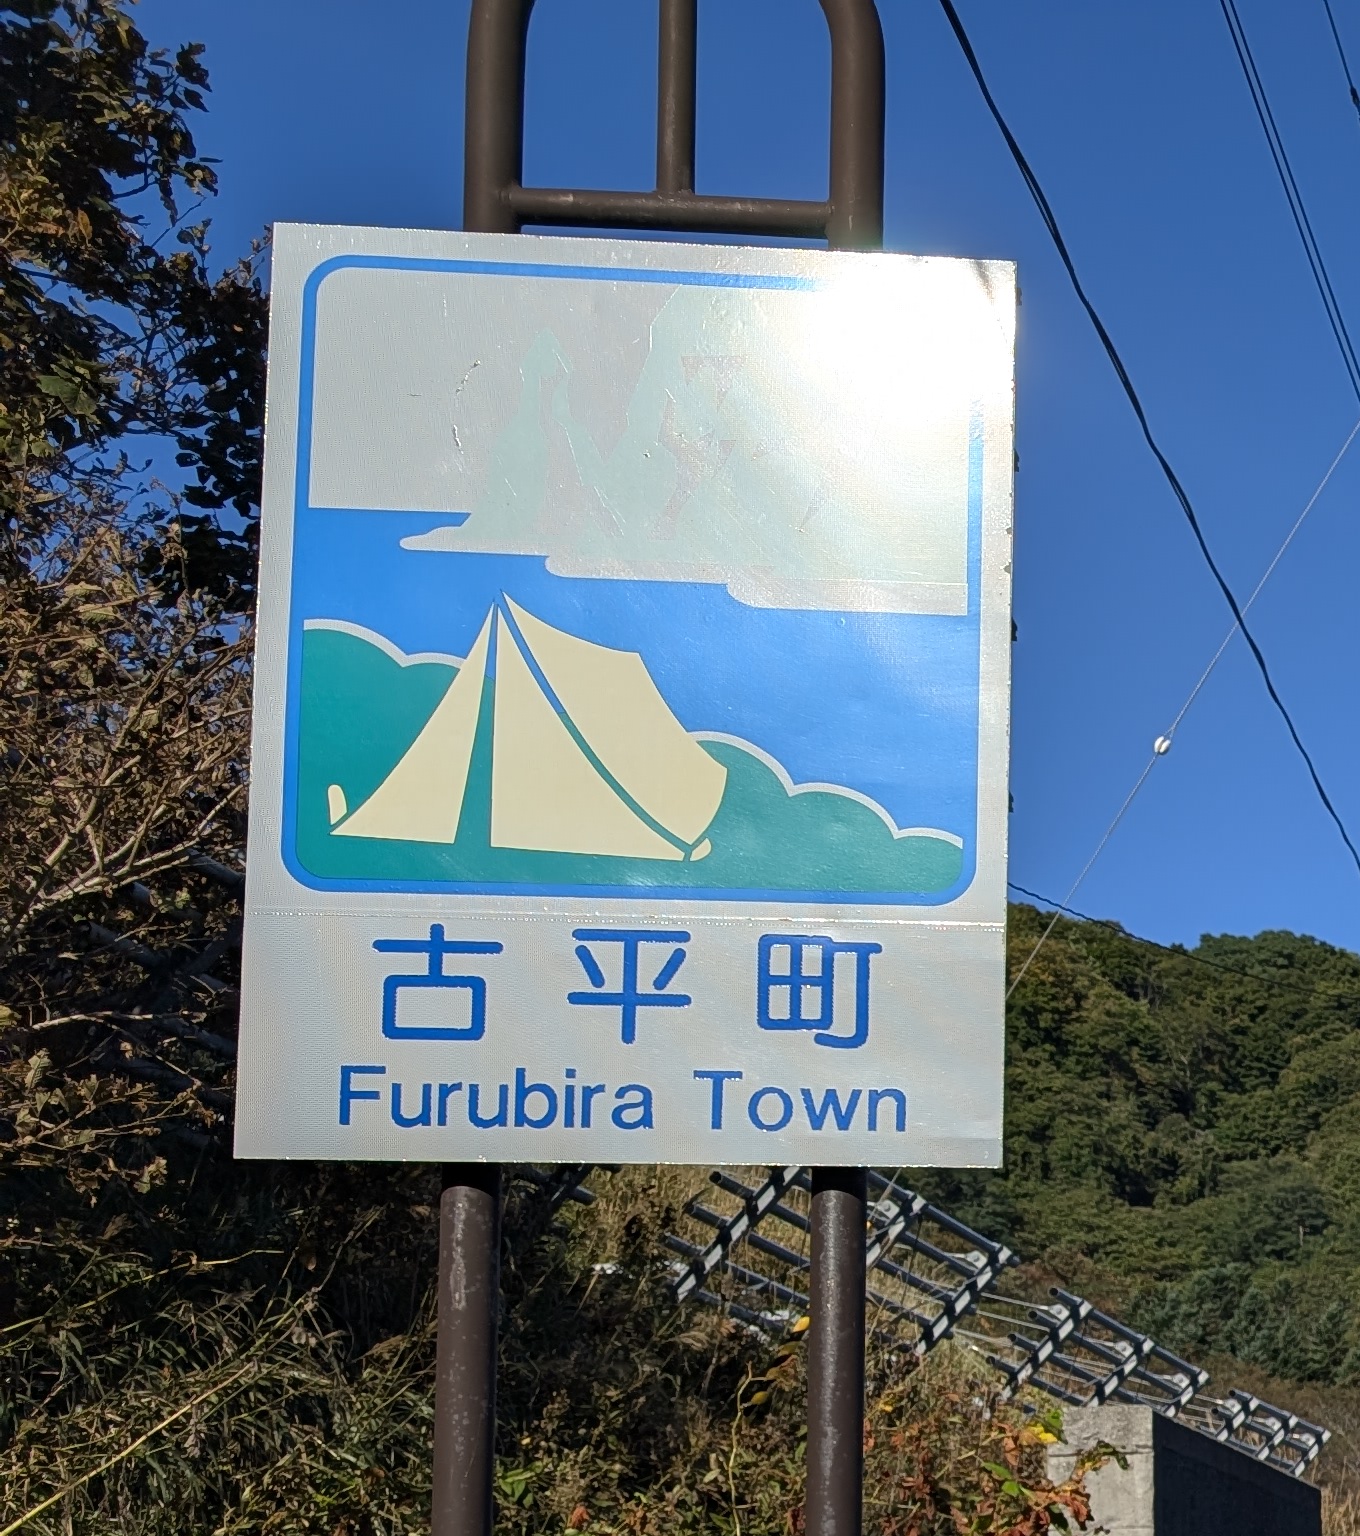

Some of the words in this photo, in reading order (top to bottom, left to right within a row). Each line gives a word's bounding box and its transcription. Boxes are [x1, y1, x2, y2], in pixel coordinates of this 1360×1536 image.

[373, 923, 882, 1048] 古平町
[338, 1065, 654, 1131] Furubira
[693, 1070, 906, 1133] Town
